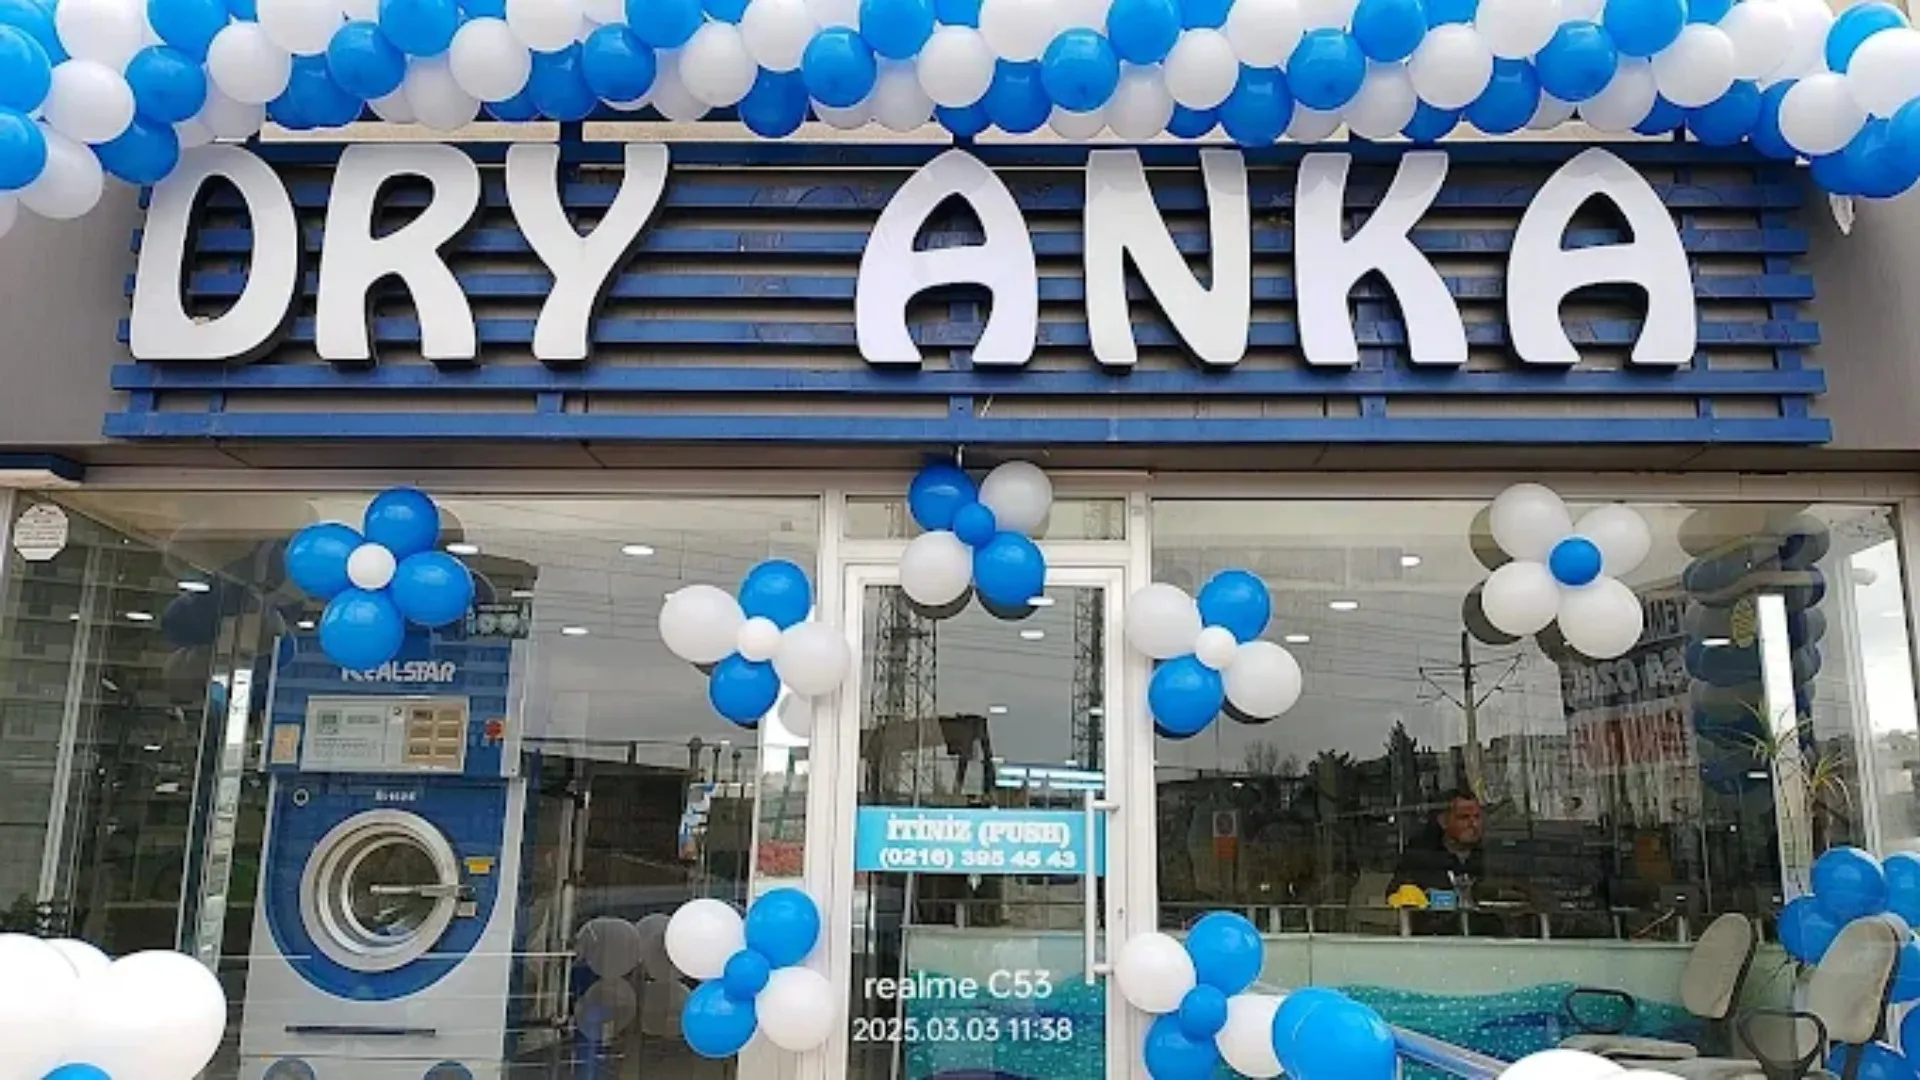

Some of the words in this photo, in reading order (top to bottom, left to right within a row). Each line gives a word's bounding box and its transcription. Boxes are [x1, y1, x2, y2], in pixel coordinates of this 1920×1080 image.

[130, 142, 671, 367] DRY
[855, 146, 1698, 368] ANKA
[887, 814, 972, 842] İTİNİZ
[978, 820, 1071, 848] (PUSH)
[879, 847, 954, 868] (0216)
[1047, 850, 1077, 868] 43
